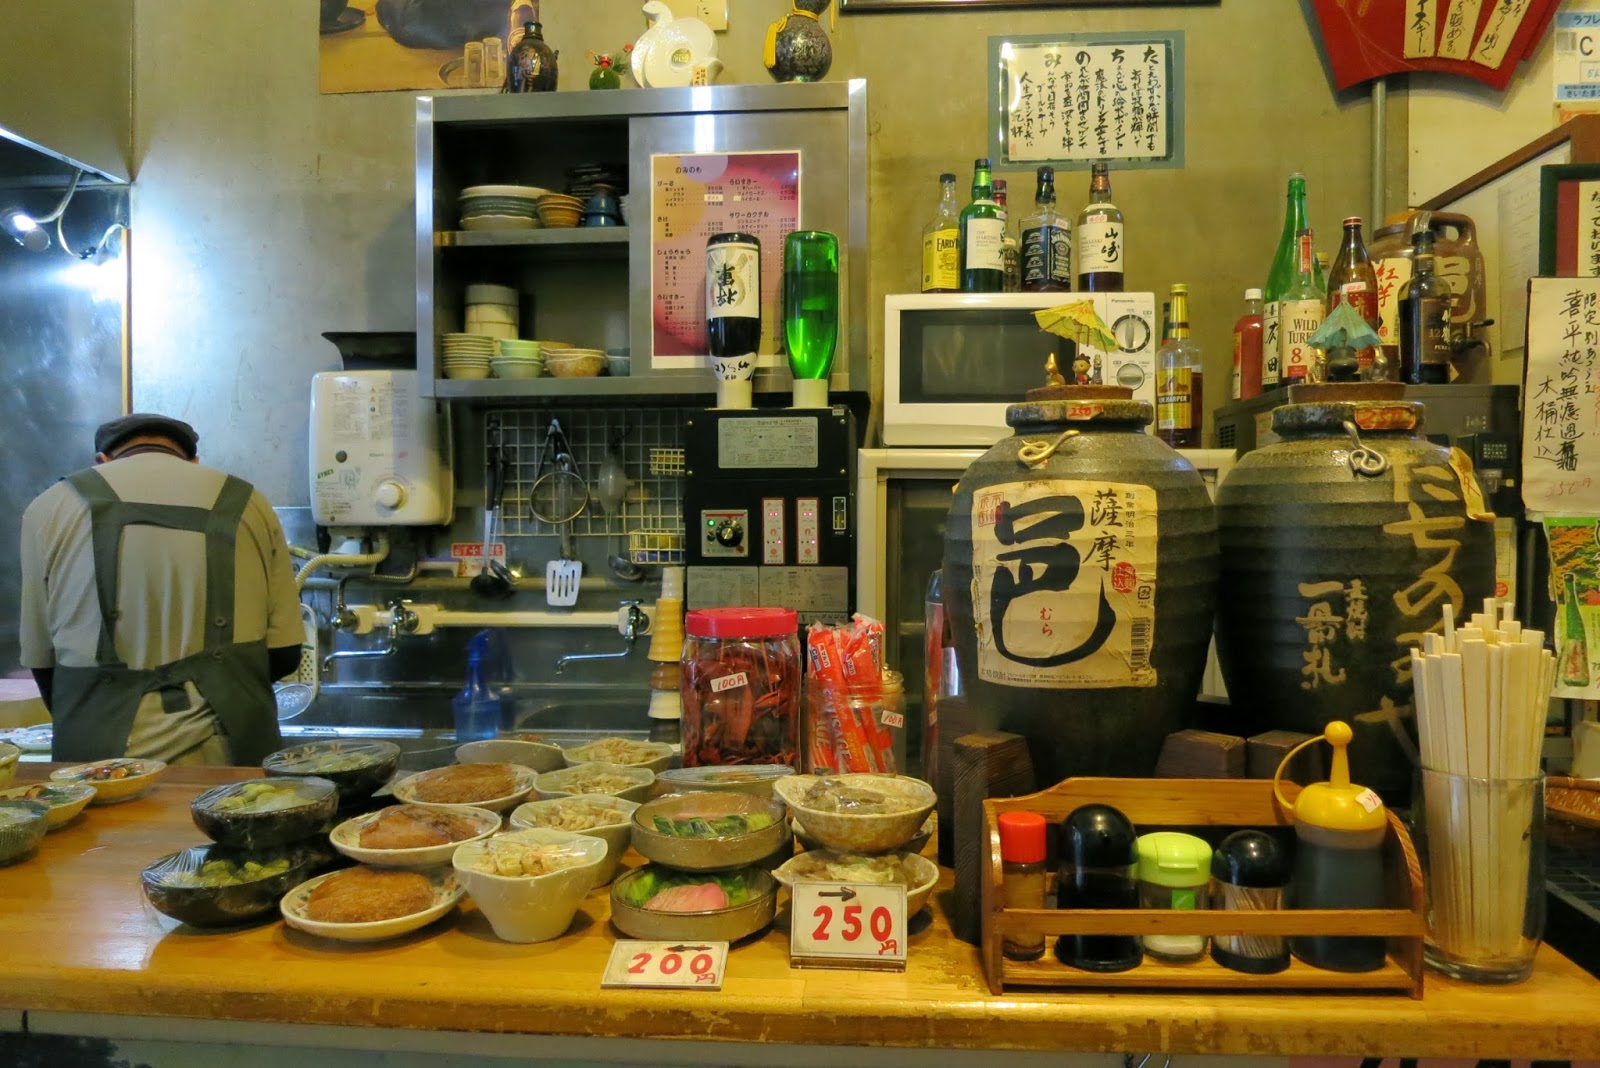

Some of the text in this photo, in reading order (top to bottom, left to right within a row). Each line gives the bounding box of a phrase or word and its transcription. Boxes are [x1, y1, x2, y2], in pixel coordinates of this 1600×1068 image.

[1288, 331, 1311, 344] TURK
[1293, 319, 1318, 331] WILD
[1291, 347, 1302, 364] 8
[1082, 487, 1124, 572] 薩摩
[1039, 607, 1053, 638] むら
[812, 905, 897, 956] 250円
[628, 952, 715, 984] 200円
